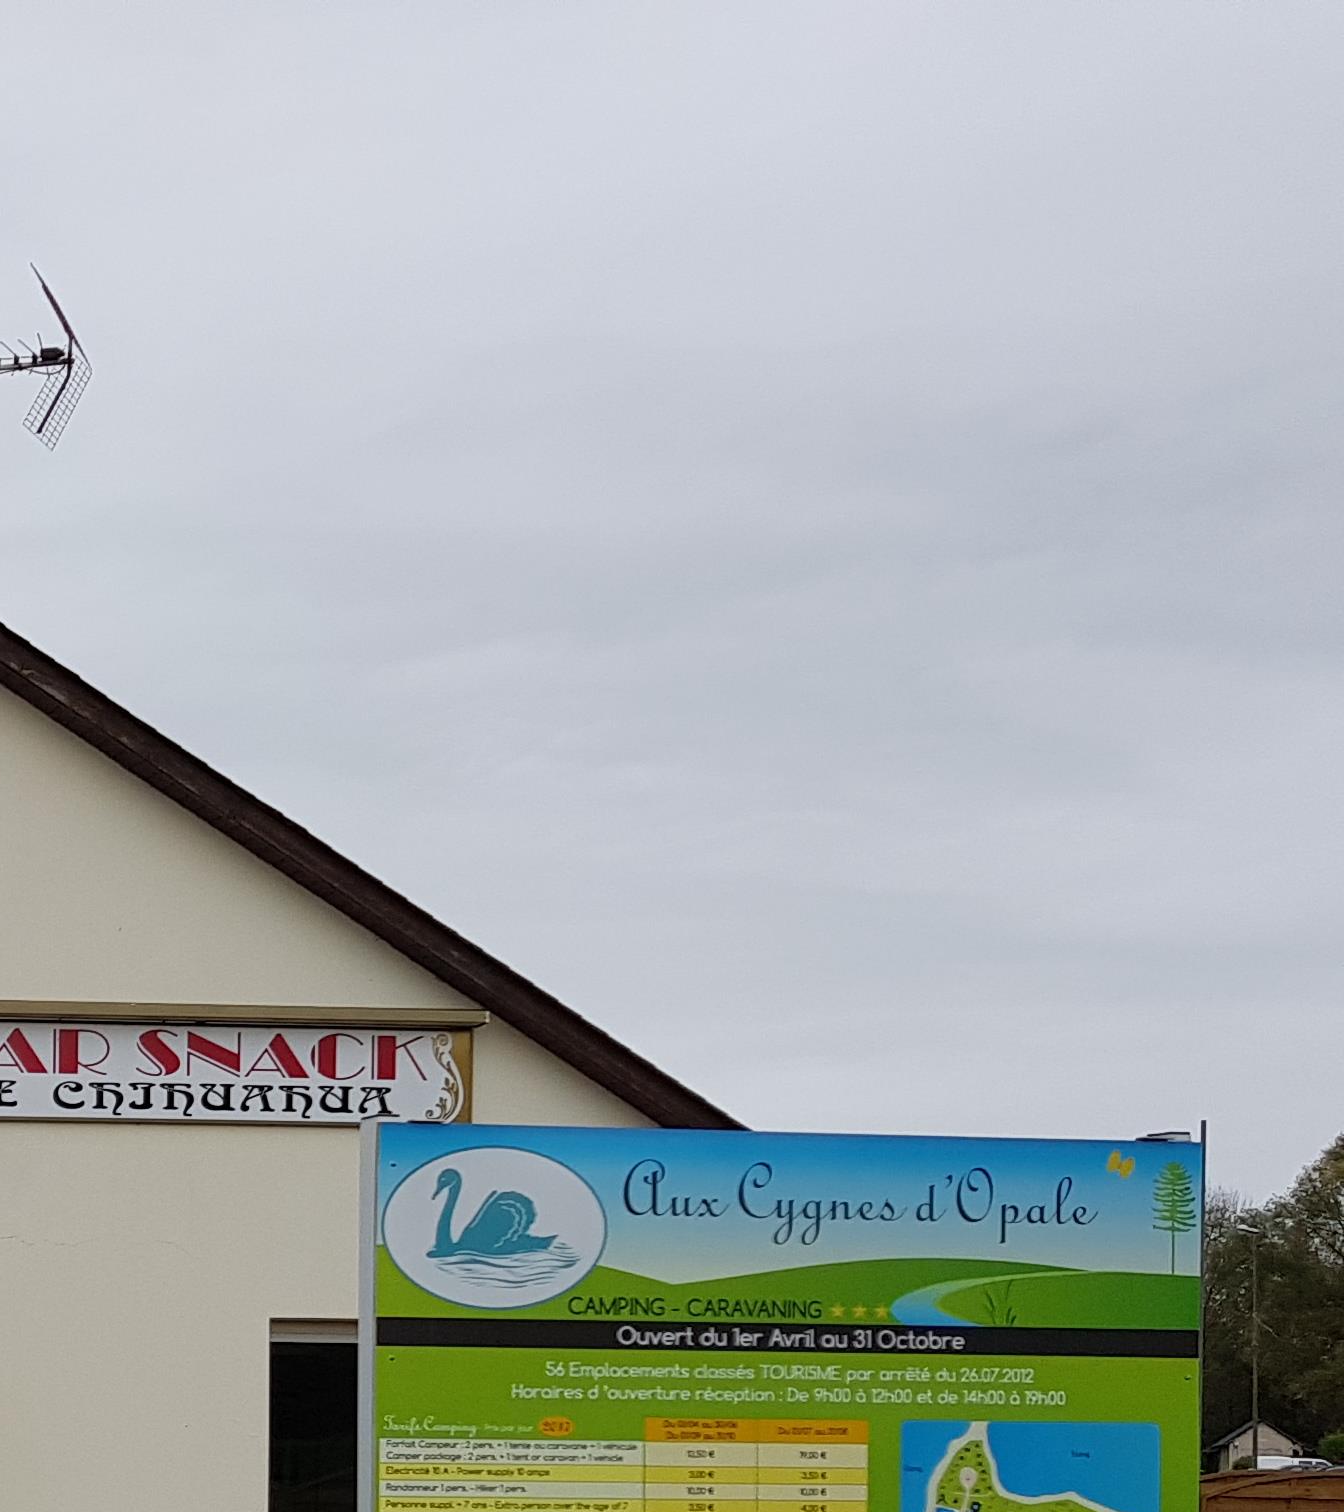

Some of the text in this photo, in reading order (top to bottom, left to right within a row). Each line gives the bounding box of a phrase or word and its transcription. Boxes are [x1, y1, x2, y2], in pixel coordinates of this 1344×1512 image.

[136, 1028, 428, 1081] SNACK
[52, 1081, 399, 1117] CHIHUAHUA
[622, 1158, 1099, 1246] Aux Cygnes d'Opale
[568, 1296, 823, 1319] CAMPING CARAVANING
[616, 1325, 966, 1350] Ouvert du 1er Avril au 31 Octobre
[546, 1361, 1034, 1384] 56 Emplacements classés TOURISME par arrêté du 26.07.2012
[511, 1384, 583, 1399] Horaires
[695, 1387, 775, 1403] réception
[787, 1388, 809, 1402] De
[815, 1388, 851, 1402] 9h00
[855, 1389, 866, 1402] à
[872, 1388, 912, 1403] 12h00
[916, 1390, 932, 1404] et
[937, 1390, 958, 1405] de
[963, 1390, 1005, 1405] 14h00
[1010, 1391, 1020, 1405] à
[1025, 1391, 1066, 1406] 19h00
